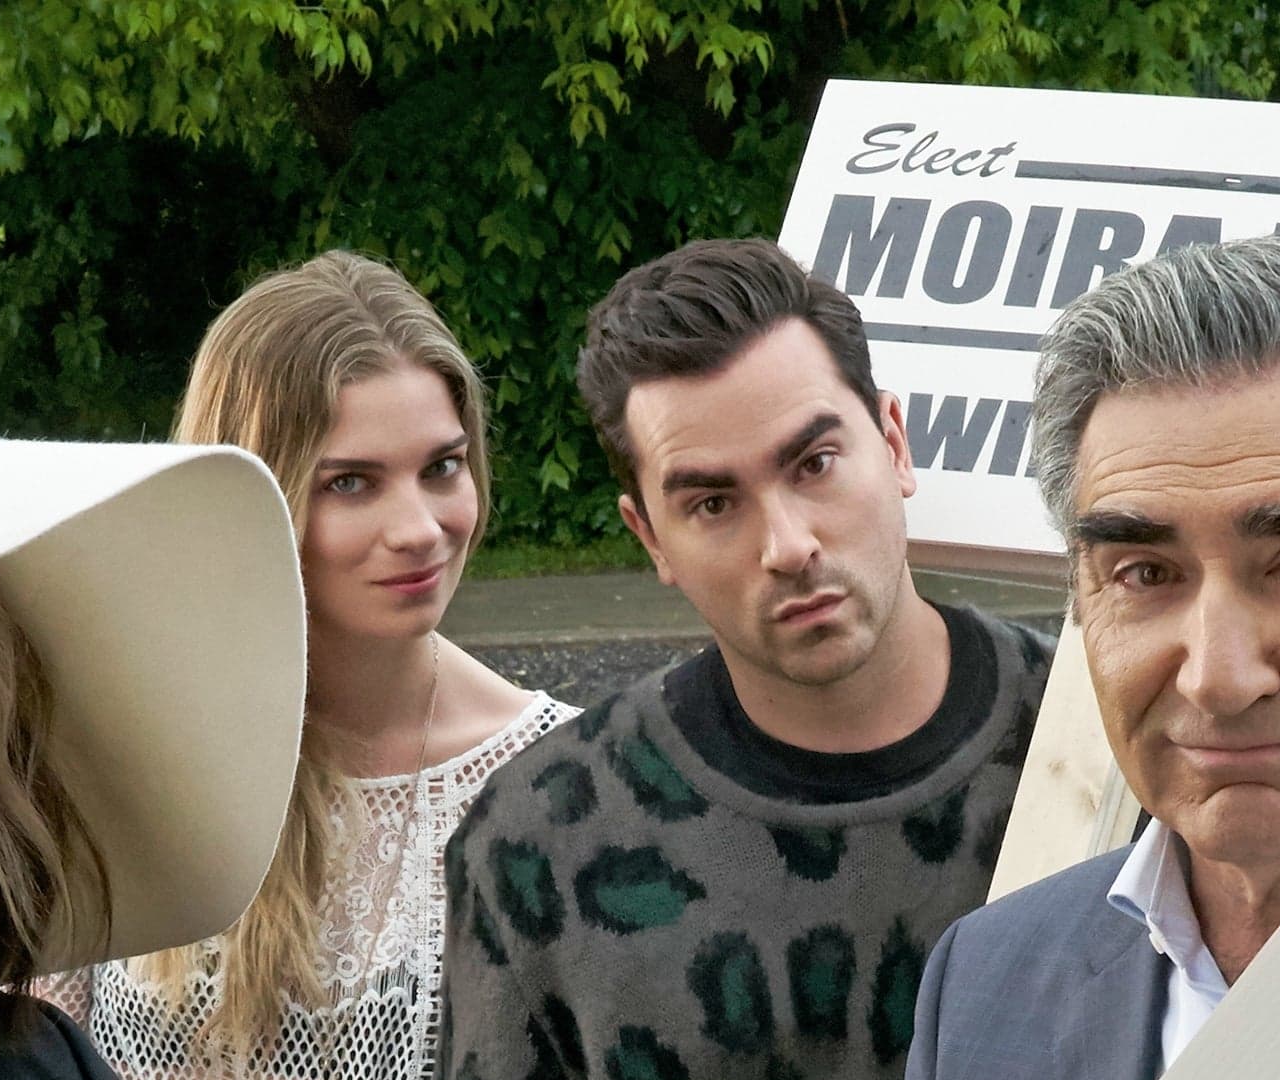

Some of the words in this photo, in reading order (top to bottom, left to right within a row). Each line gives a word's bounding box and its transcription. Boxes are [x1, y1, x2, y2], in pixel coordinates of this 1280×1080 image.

[846, 123, 1017, 178] Elect
[809, 194, 1223, 309] MOIR
[905, 392, 1038, 478] wn
